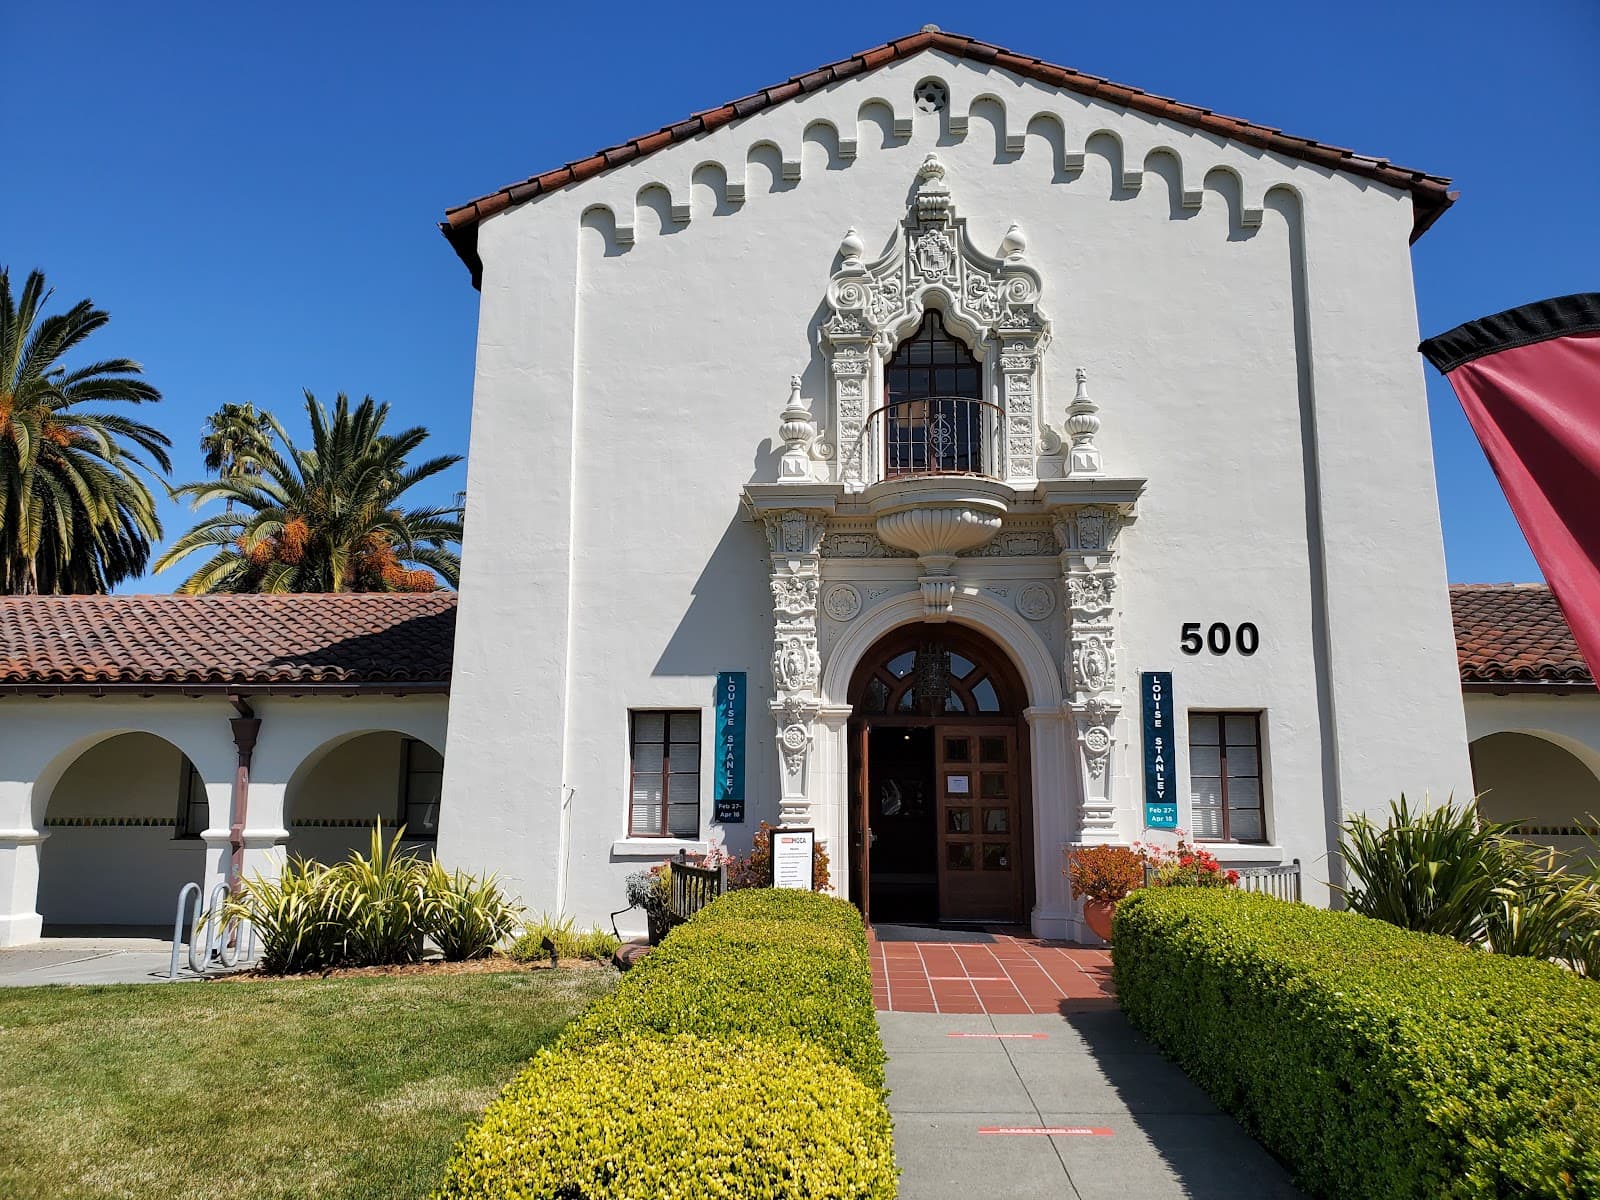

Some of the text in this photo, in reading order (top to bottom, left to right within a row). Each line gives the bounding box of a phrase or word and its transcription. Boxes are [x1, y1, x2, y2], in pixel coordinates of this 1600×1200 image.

[1180, 622, 1259, 656] 500
[726, 676, 736, 795] LOUISE STANLEY
[1152, 676, 1165, 799] LOUISE STANLEY
